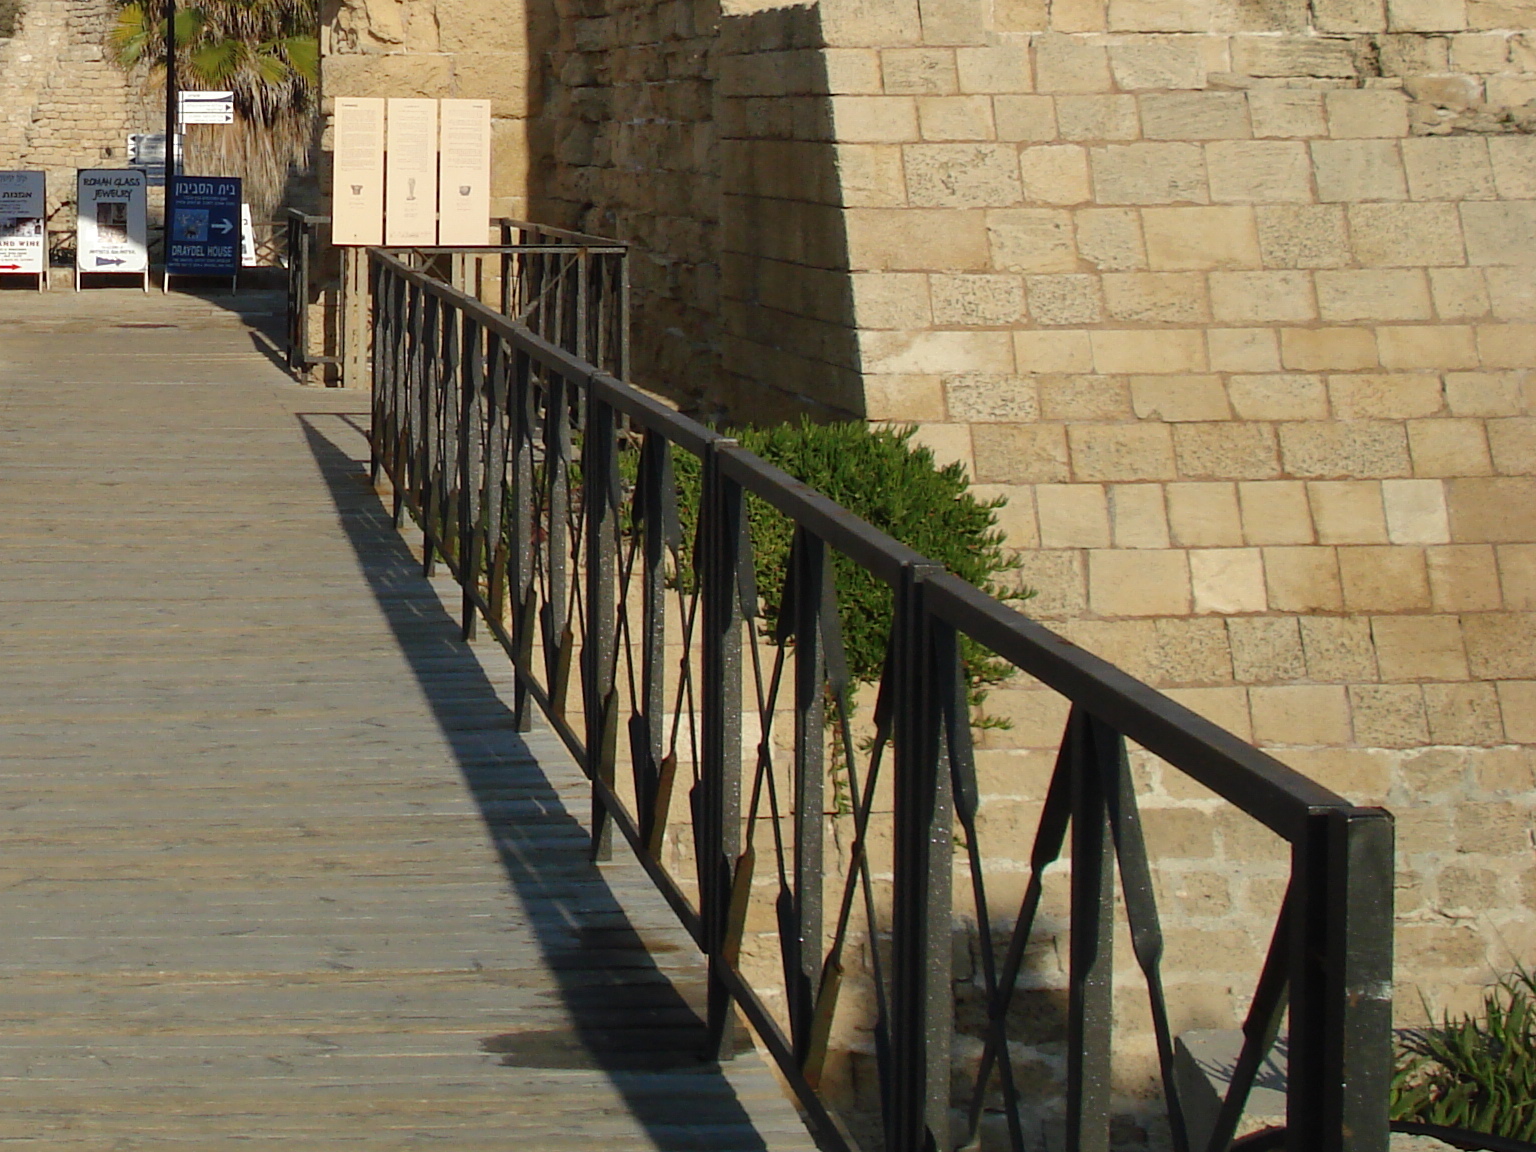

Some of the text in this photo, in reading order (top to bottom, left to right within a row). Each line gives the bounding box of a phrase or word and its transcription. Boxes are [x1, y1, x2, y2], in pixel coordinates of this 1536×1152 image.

[83, 177, 140, 186] ROMAN GLASS
[92, 189, 132, 201] JEWELRY
[175, 182, 235, 196] בית הסביבון
[171, 245, 233, 257] DRAYDEL HOUSE
